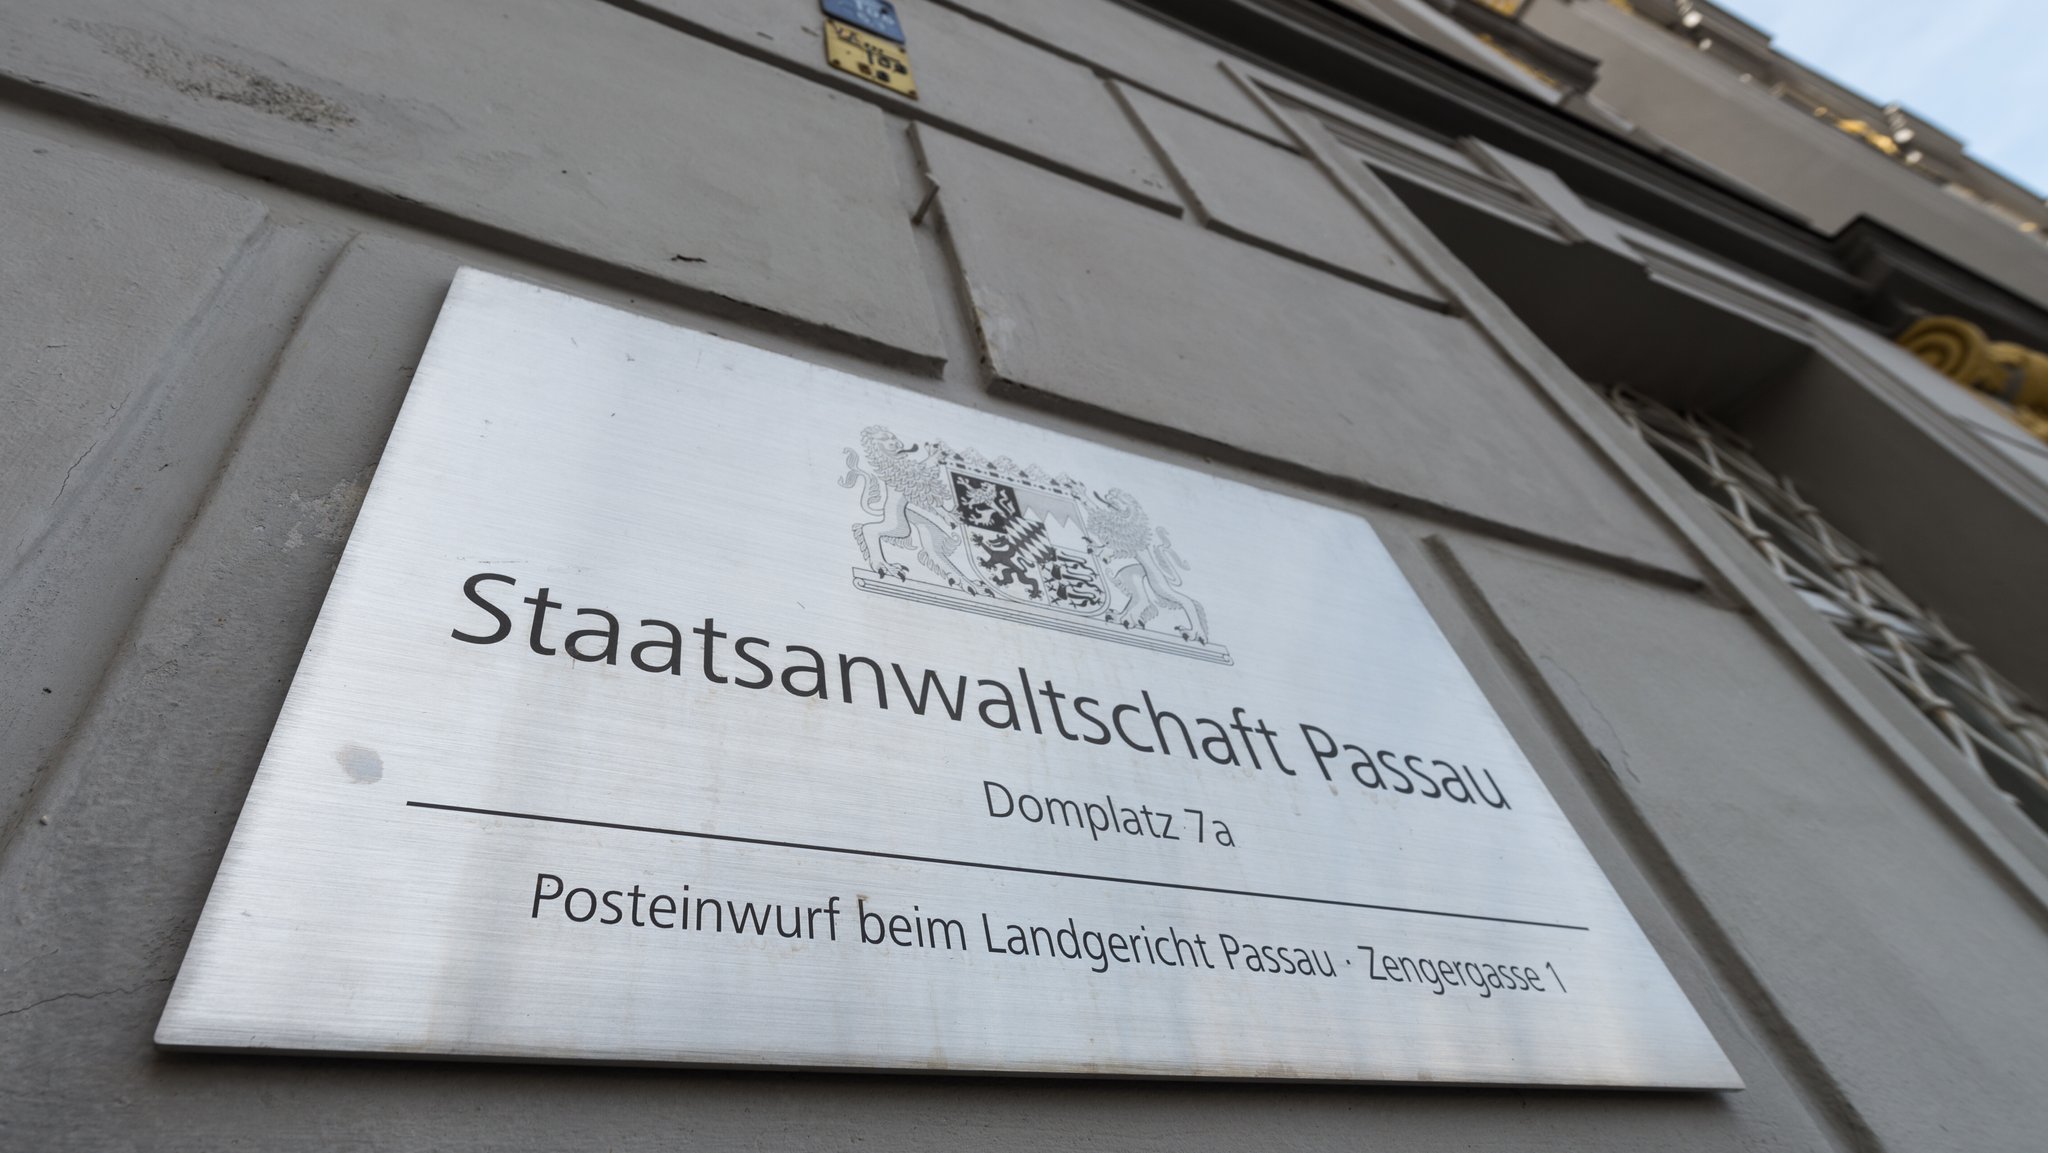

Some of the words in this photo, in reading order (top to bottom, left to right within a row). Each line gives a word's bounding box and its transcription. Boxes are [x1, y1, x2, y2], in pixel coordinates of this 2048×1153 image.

[450, 572, 1297, 777] Staatsanwaltschaft
[1298, 722, 1512, 811] Passau
[983, 780, 1181, 842] Domplatz
[1183, 808, 1237, 848] 7a
[531, 872, 841, 942] Posteinwurf
[857, 894, 968, 951] beim
[981, 912, 1216, 974] Landgericht
[1218, 933, 1338, 978] Passau
[1356, 945, 1546, 999] Zengergasse
[1545, 961, 1568, 994] 1
